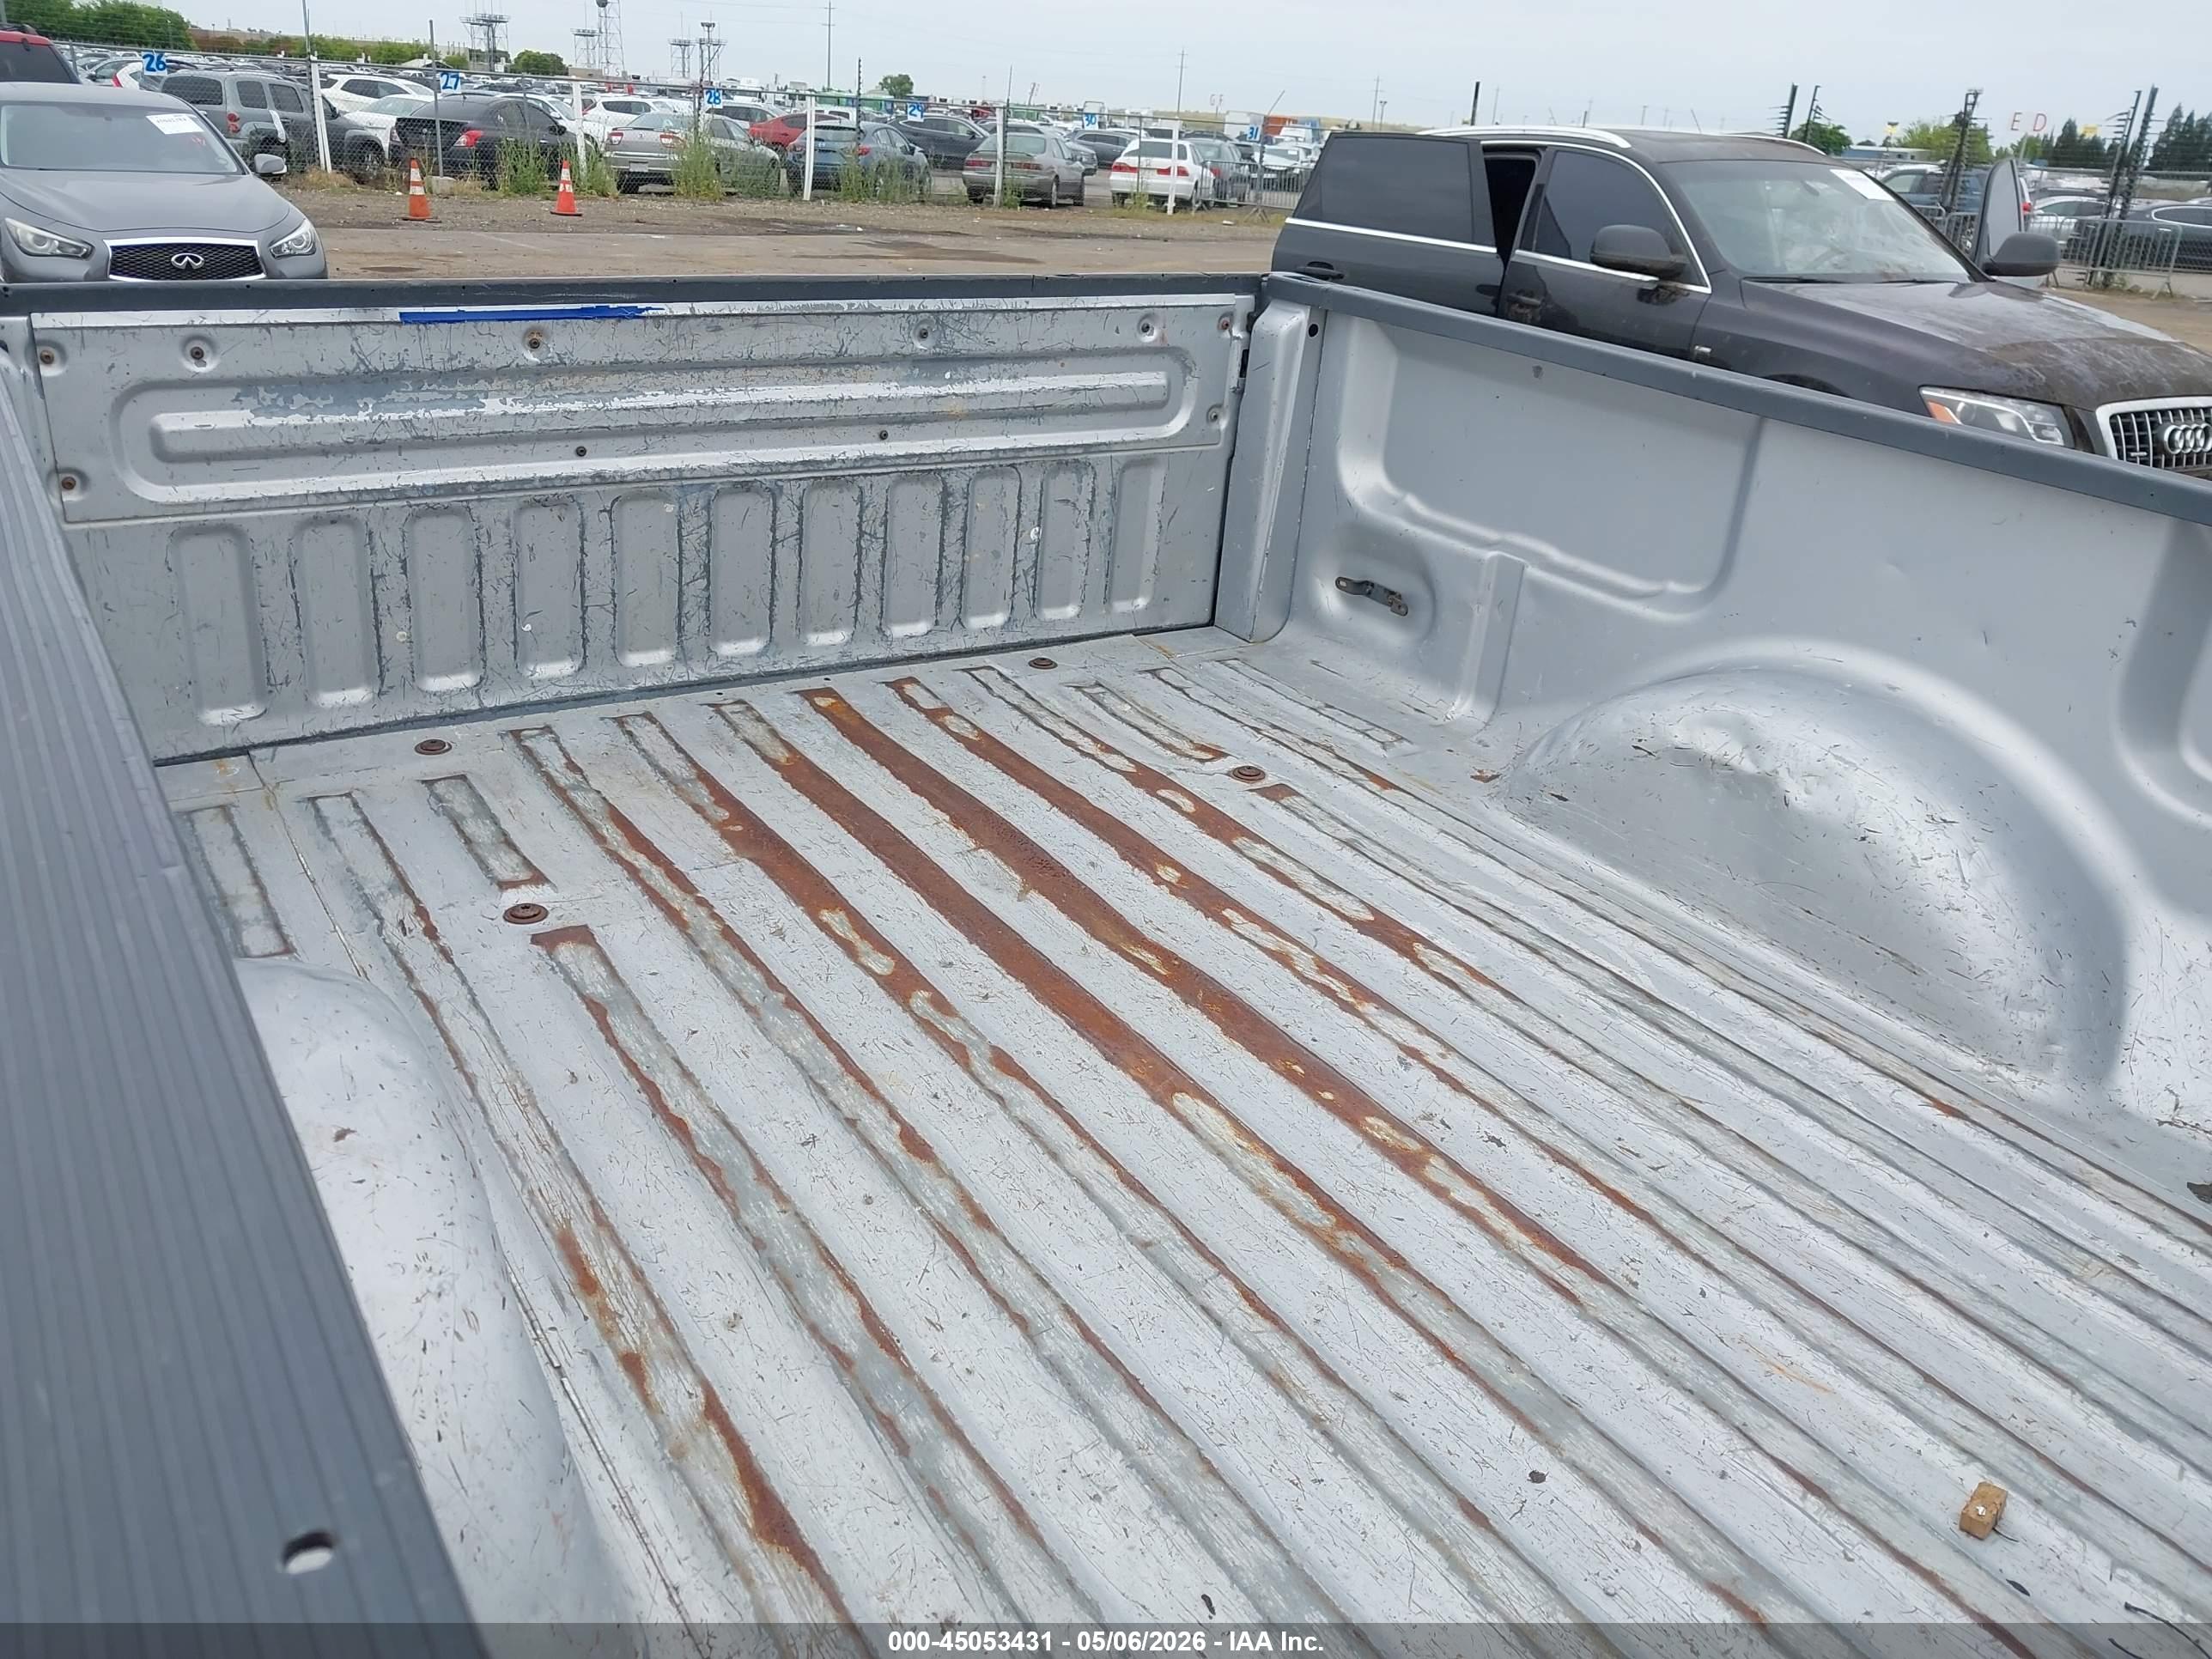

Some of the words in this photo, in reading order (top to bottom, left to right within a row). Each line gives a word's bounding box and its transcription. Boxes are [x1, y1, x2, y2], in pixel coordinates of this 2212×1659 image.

[142, 53, 167, 72] 26
[440, 72, 460, 90] 27
[706, 88, 721, 105] 28
[908, 103, 925, 118] 29
[1085, 113, 1097, 126] 30
[2010, 112, 2022, 131] E
[2033, 112, 2047, 131] D
[1249, 126, 1259, 140] 31
